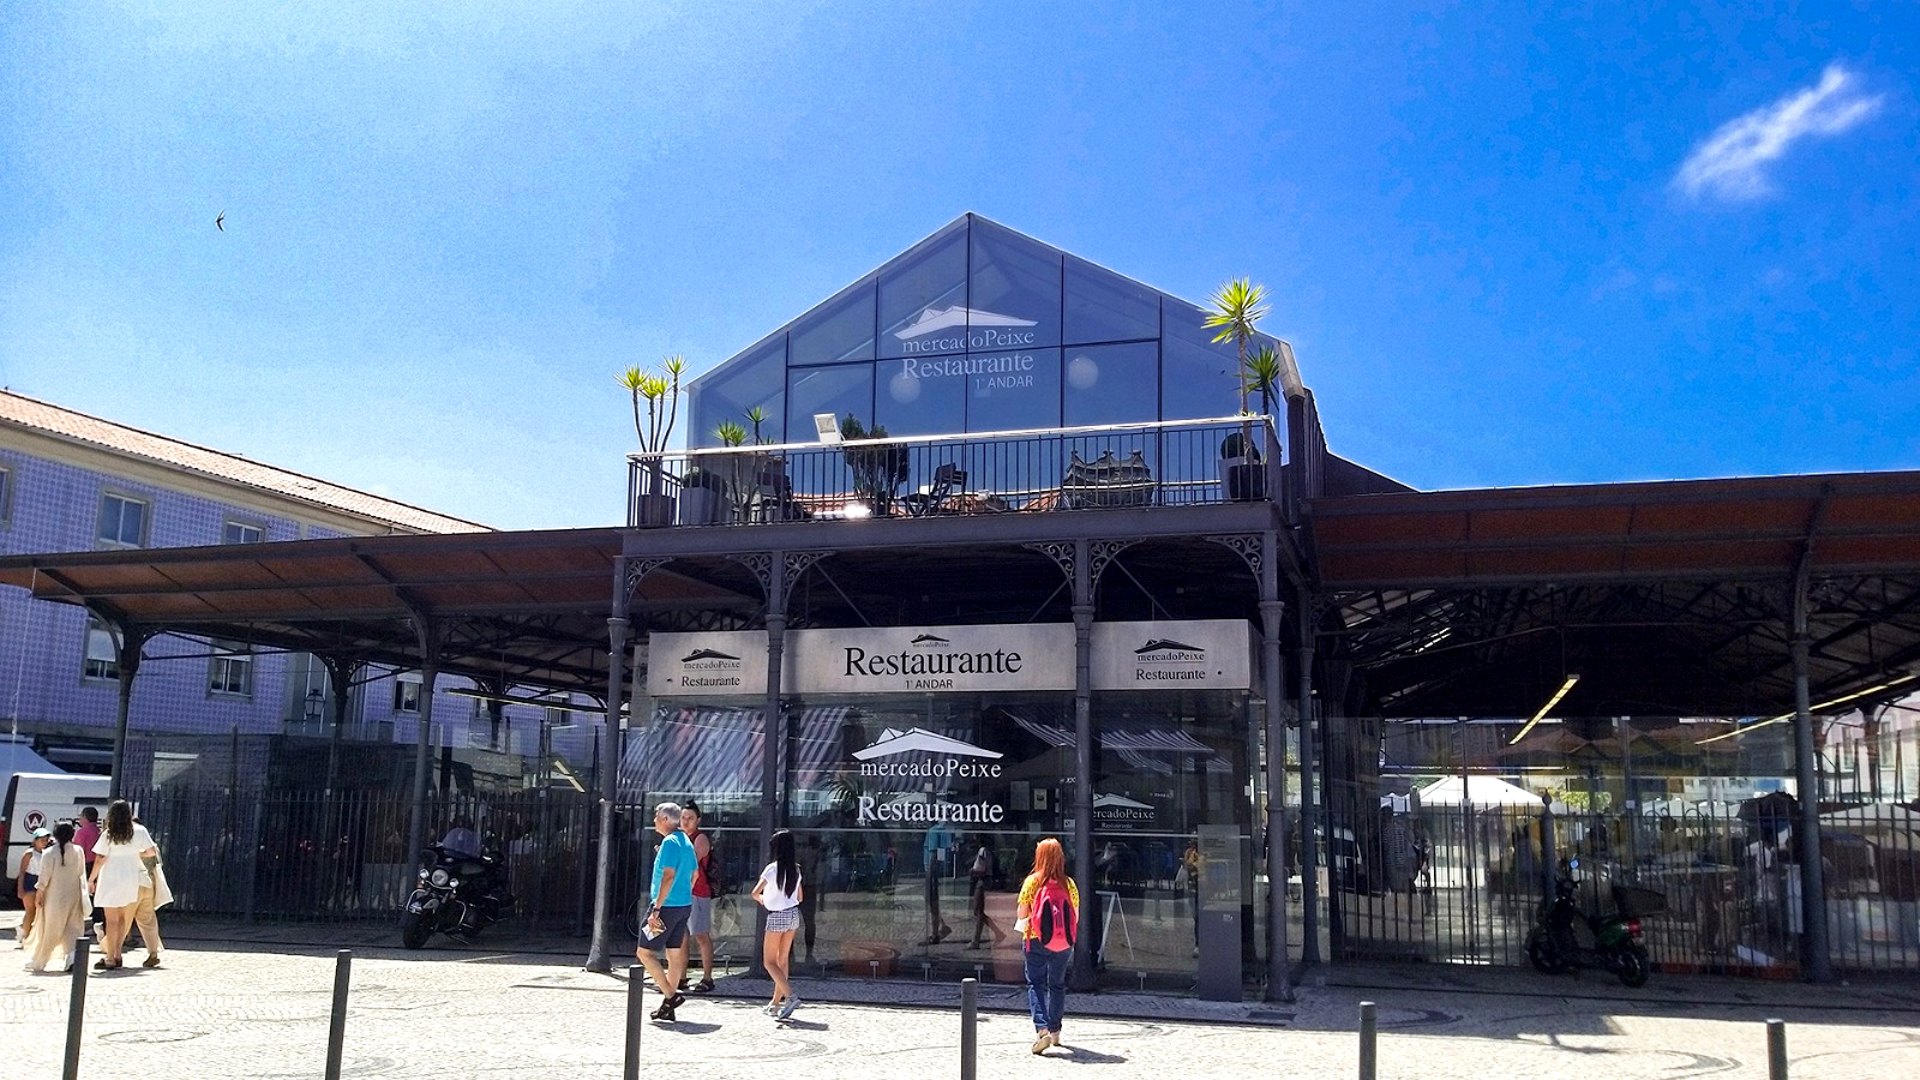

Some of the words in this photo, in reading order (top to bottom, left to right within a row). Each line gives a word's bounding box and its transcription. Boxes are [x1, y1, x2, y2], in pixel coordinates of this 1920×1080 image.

[902, 328, 1035, 353] mercadoPeixe
[902, 353, 1034, 379] Restaurante
[987, 375, 1033, 389] ANDAR
[845, 648, 1022, 676] Restaurante
[1137, 651, 1205, 661] mercadoPeixe
[683, 660, 741, 669] mercadoPeixe
[681, 676, 741, 687] Restaurante
[1135, 669, 1206, 680] Restaurante
[915, 679, 953, 689] ANDAR
[860, 758, 1001, 777] mercadoPeixe
[857, 796, 1004, 823] Restaurante
